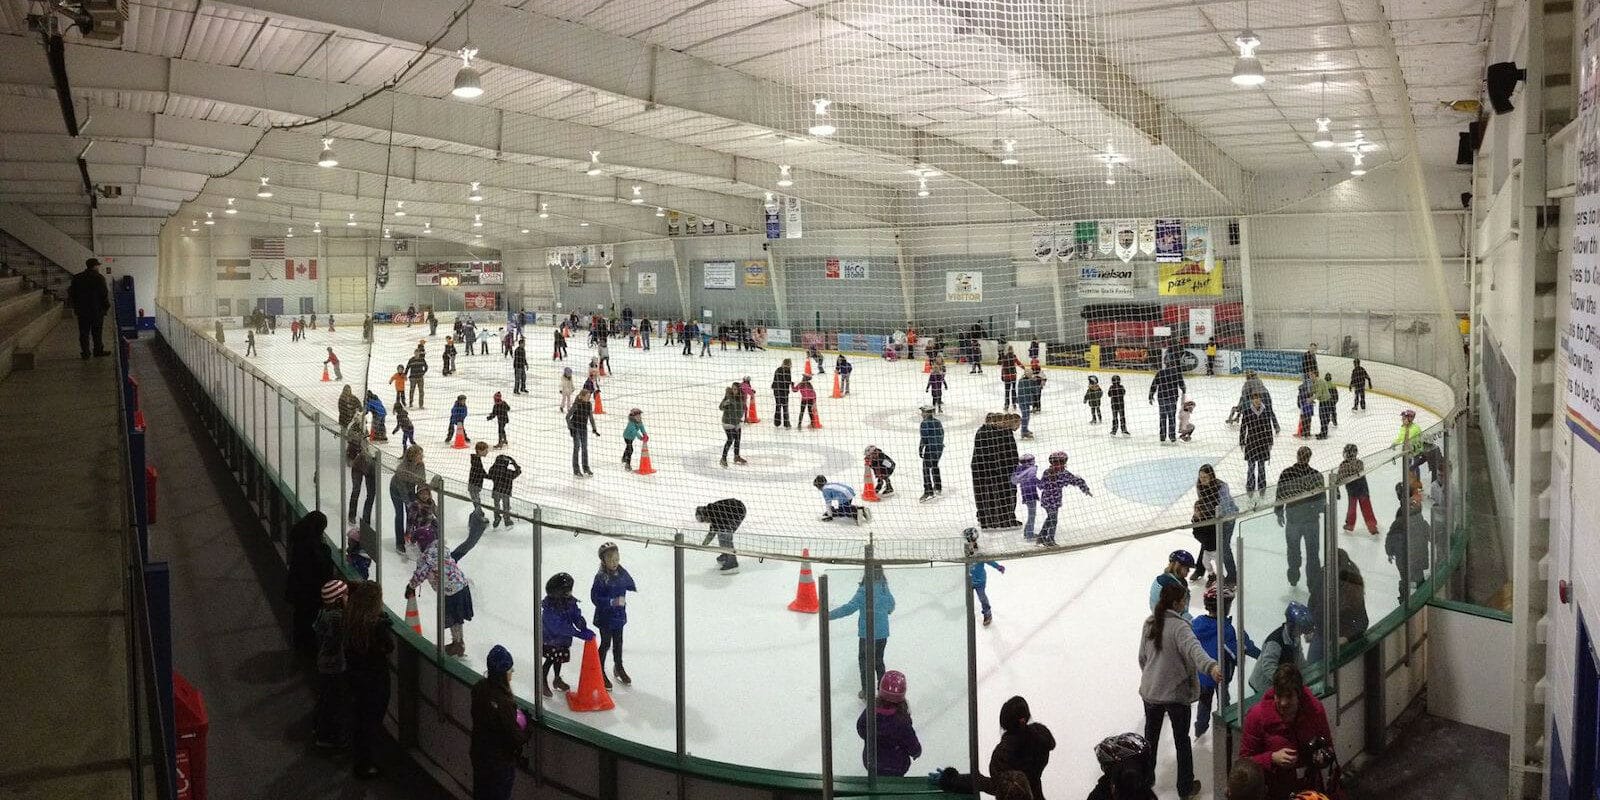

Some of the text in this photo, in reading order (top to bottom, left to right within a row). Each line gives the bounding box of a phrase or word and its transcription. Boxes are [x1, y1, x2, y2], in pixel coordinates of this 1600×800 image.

[948, 293, 981, 301] VISITOR
[1574, 379, 1581, 398] to
[1581, 382, 1589, 404] be
